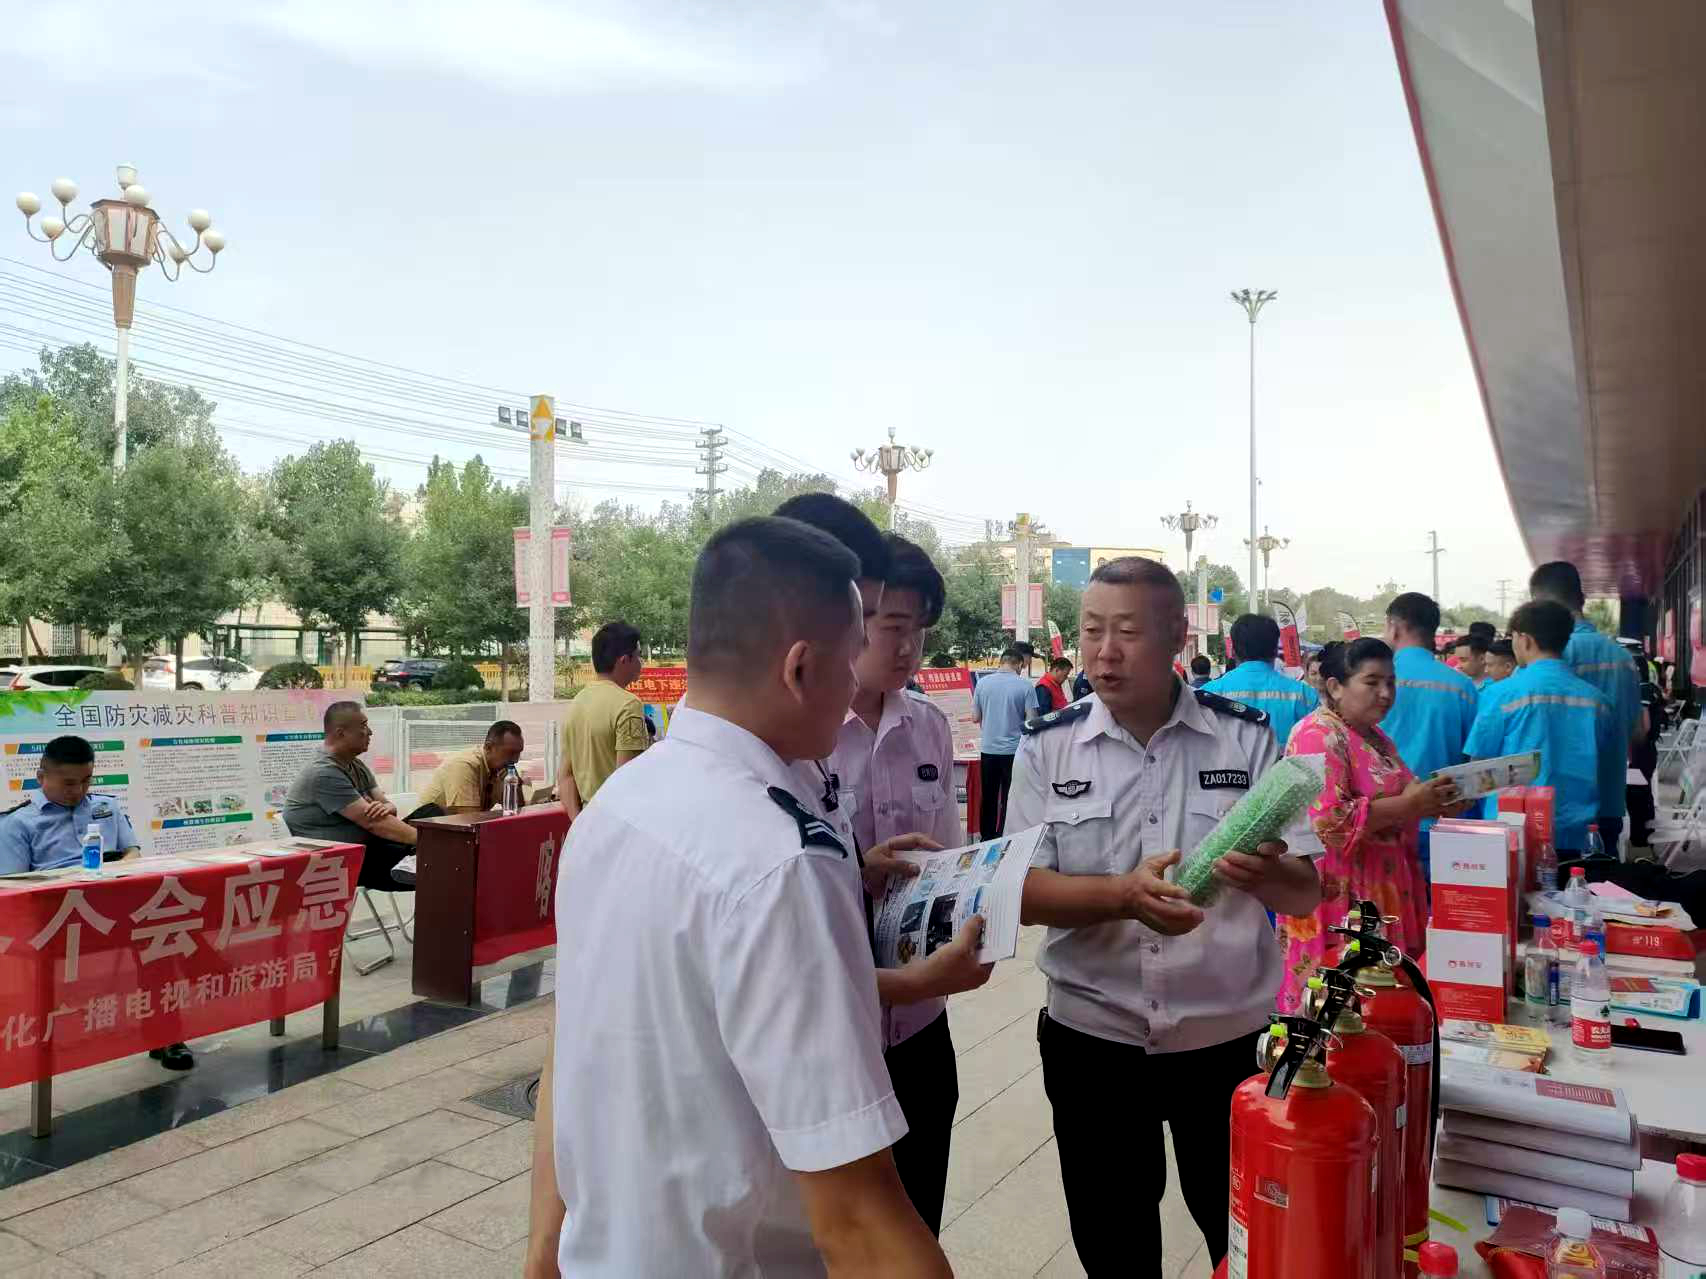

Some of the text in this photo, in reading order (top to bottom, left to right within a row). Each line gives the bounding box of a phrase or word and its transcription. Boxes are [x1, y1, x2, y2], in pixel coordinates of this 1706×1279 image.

[1203, 771, 1247, 786] ZA017233
[0, 853, 351, 984] 个会应急
